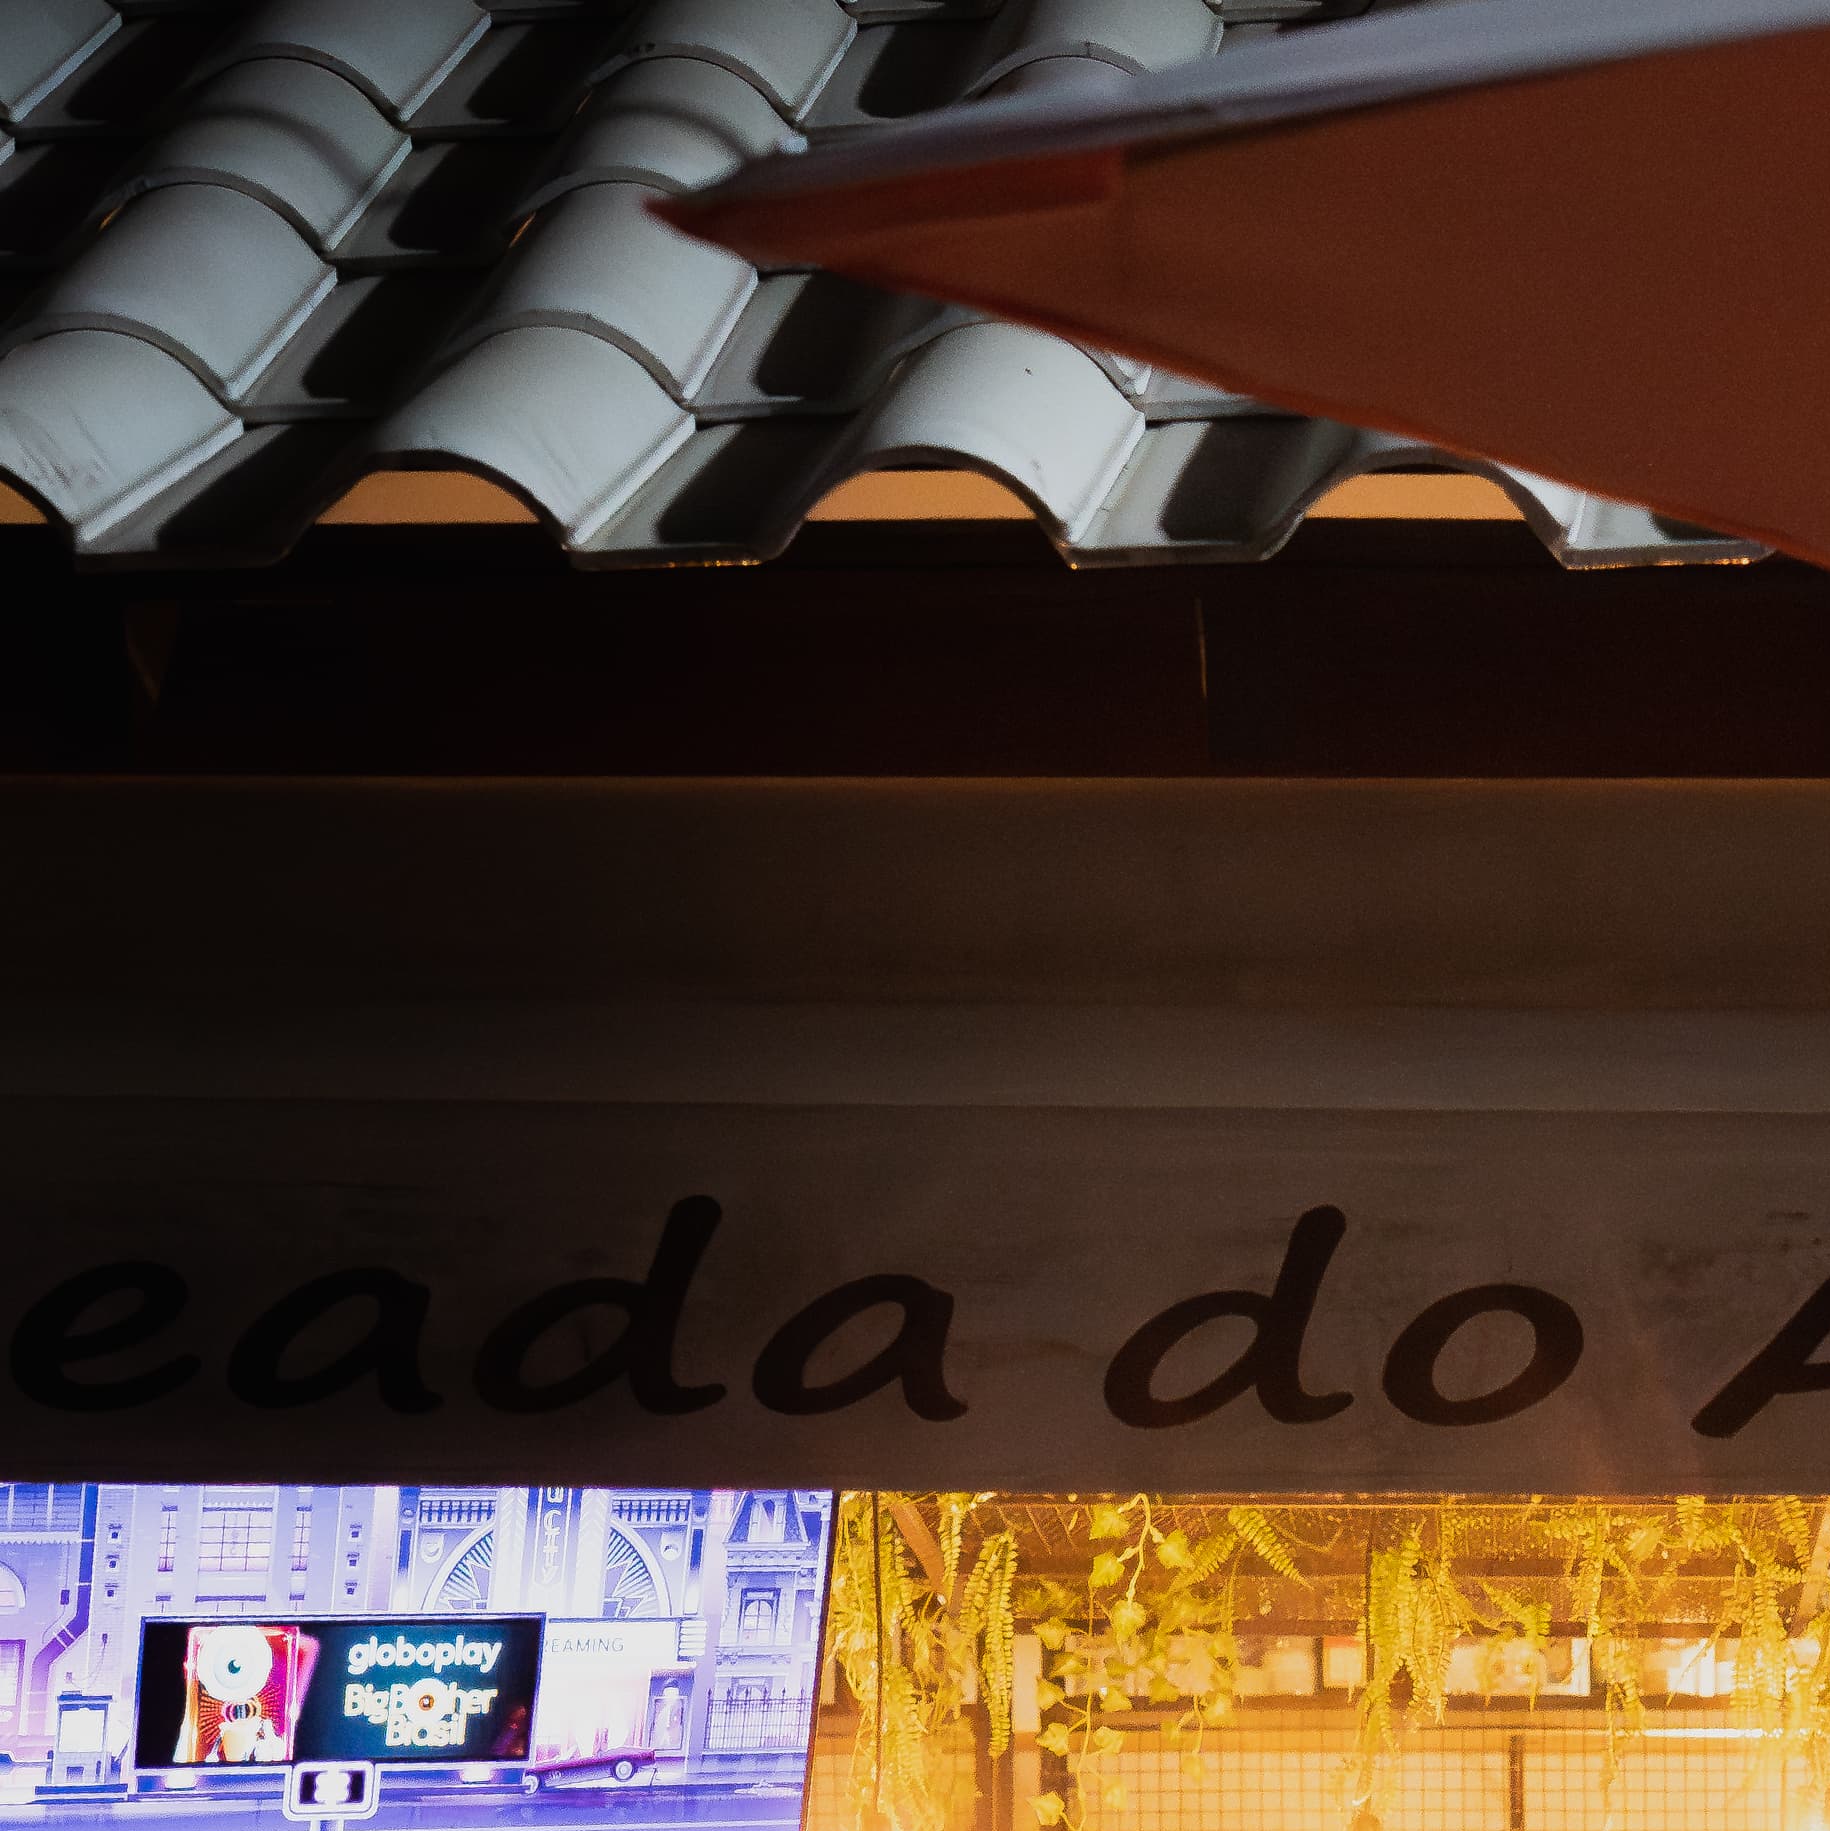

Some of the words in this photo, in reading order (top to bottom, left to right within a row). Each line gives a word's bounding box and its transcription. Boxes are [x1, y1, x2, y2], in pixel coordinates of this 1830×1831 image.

[9, 1194, 969, 1422] eada
[1103, 1204, 1584, 1429] do
[348, 1635, 502, 1674] globoplay
[345, 1683, 389, 1724] Big
